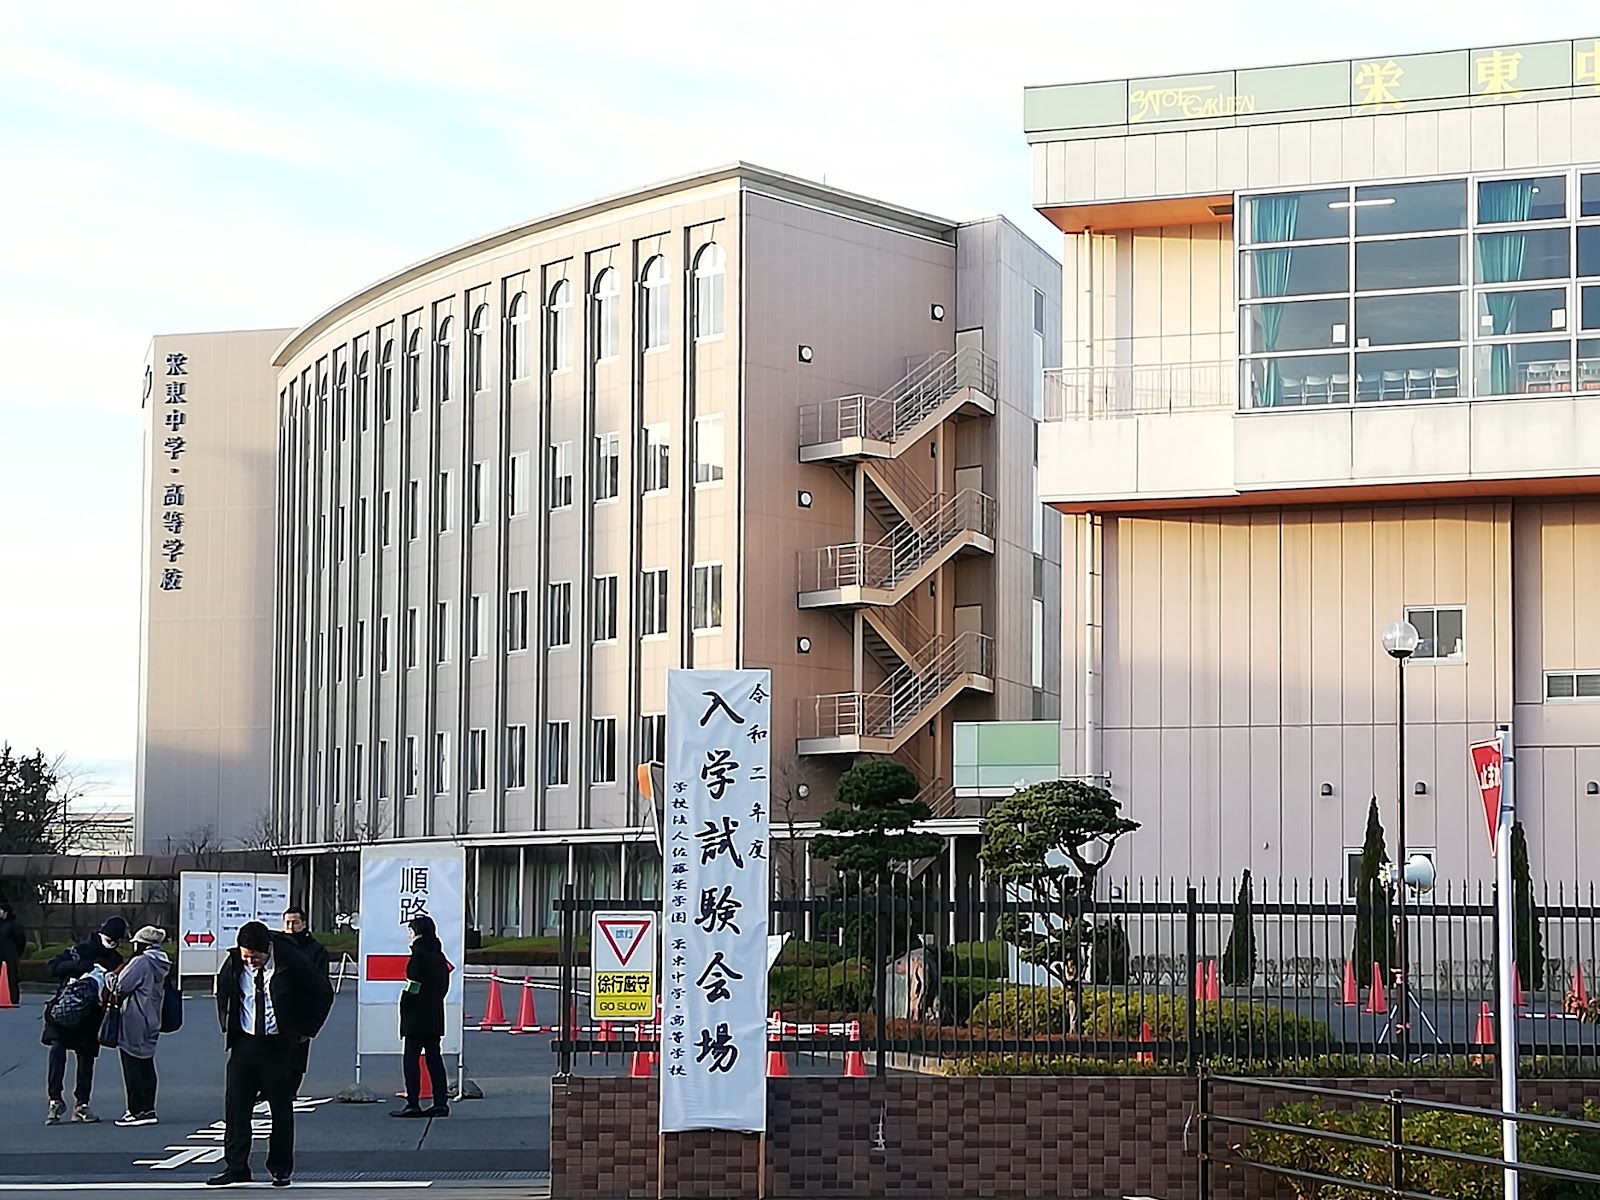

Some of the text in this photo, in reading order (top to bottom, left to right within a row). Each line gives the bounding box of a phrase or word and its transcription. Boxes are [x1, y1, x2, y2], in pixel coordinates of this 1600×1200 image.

[160, 353, 188, 591] 栄東中学・高等学校
[746, 683, 769, 860] 令和二年度
[399, 866, 429, 925] 順路
[693, 691, 745, 1073] 入学試験会場
[598, 975, 650, 994] 徐行厳守
[600, 1002, 647, 1011] GO SLOW
